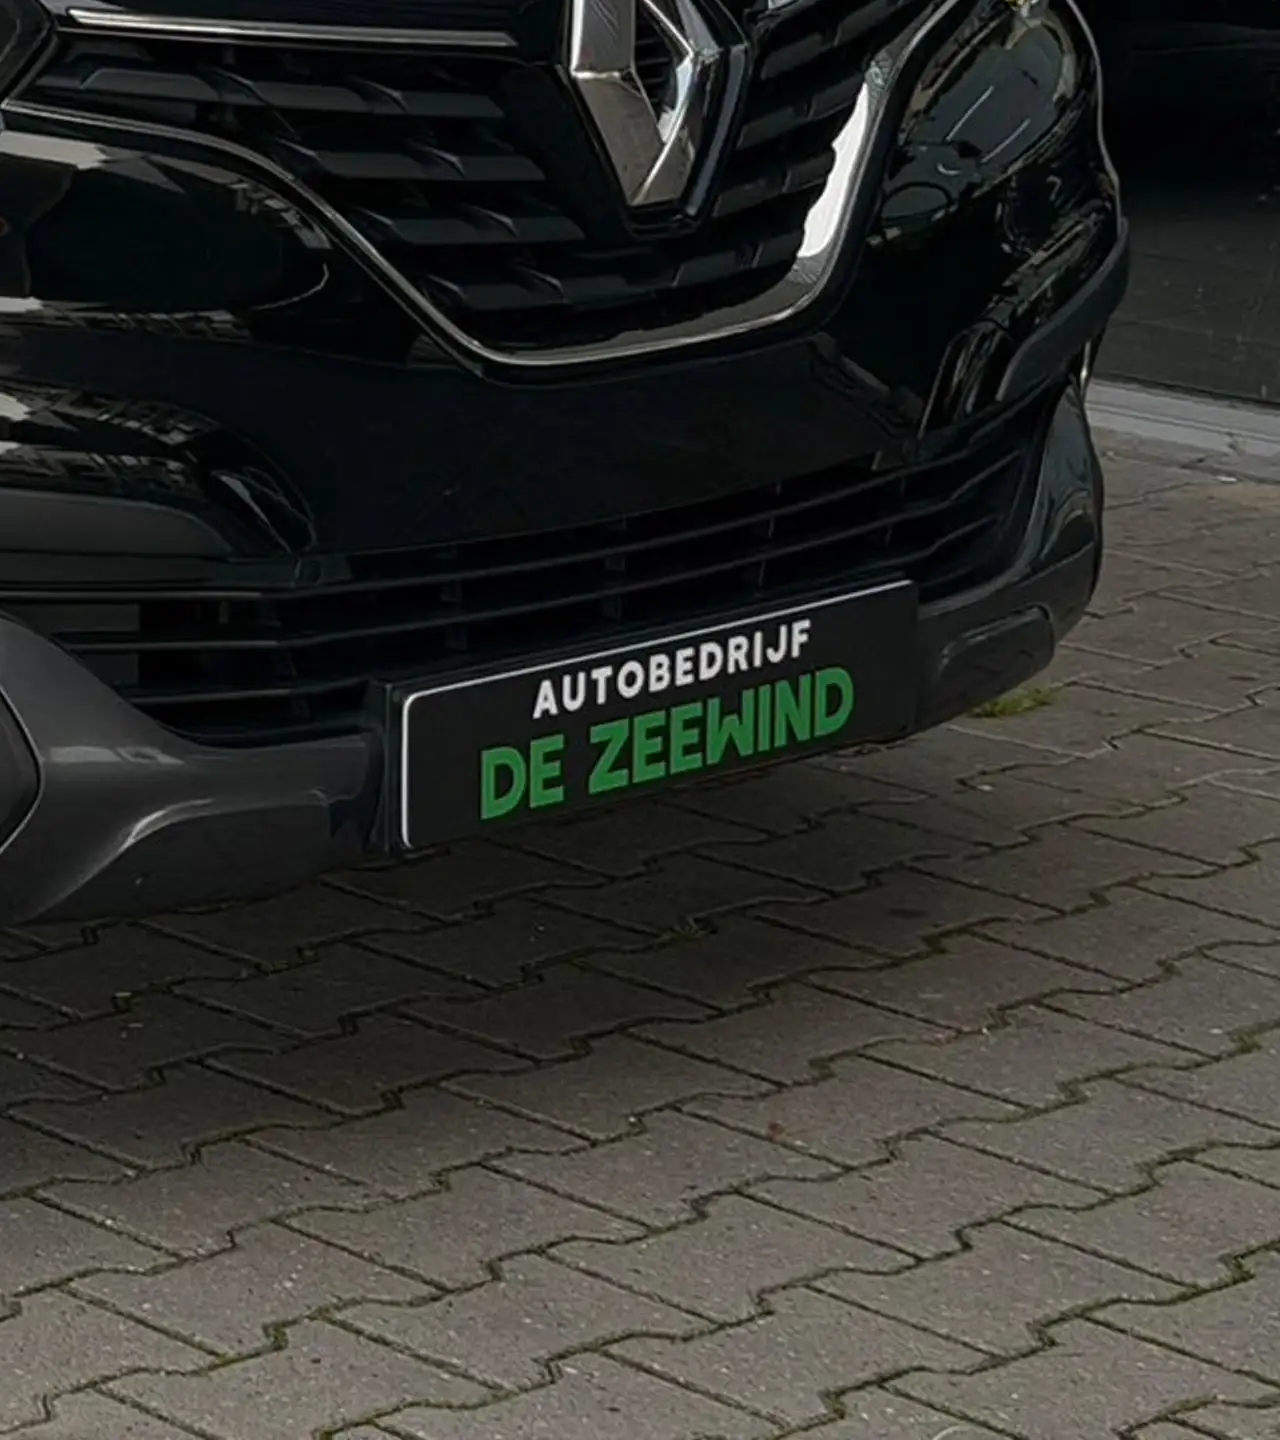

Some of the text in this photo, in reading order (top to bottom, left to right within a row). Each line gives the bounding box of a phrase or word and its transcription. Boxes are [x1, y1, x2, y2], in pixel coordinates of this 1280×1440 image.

[532, 618, 812, 719] AUTOBEDRIJF
[480, 666, 855, 820] DE ZEEWIND
